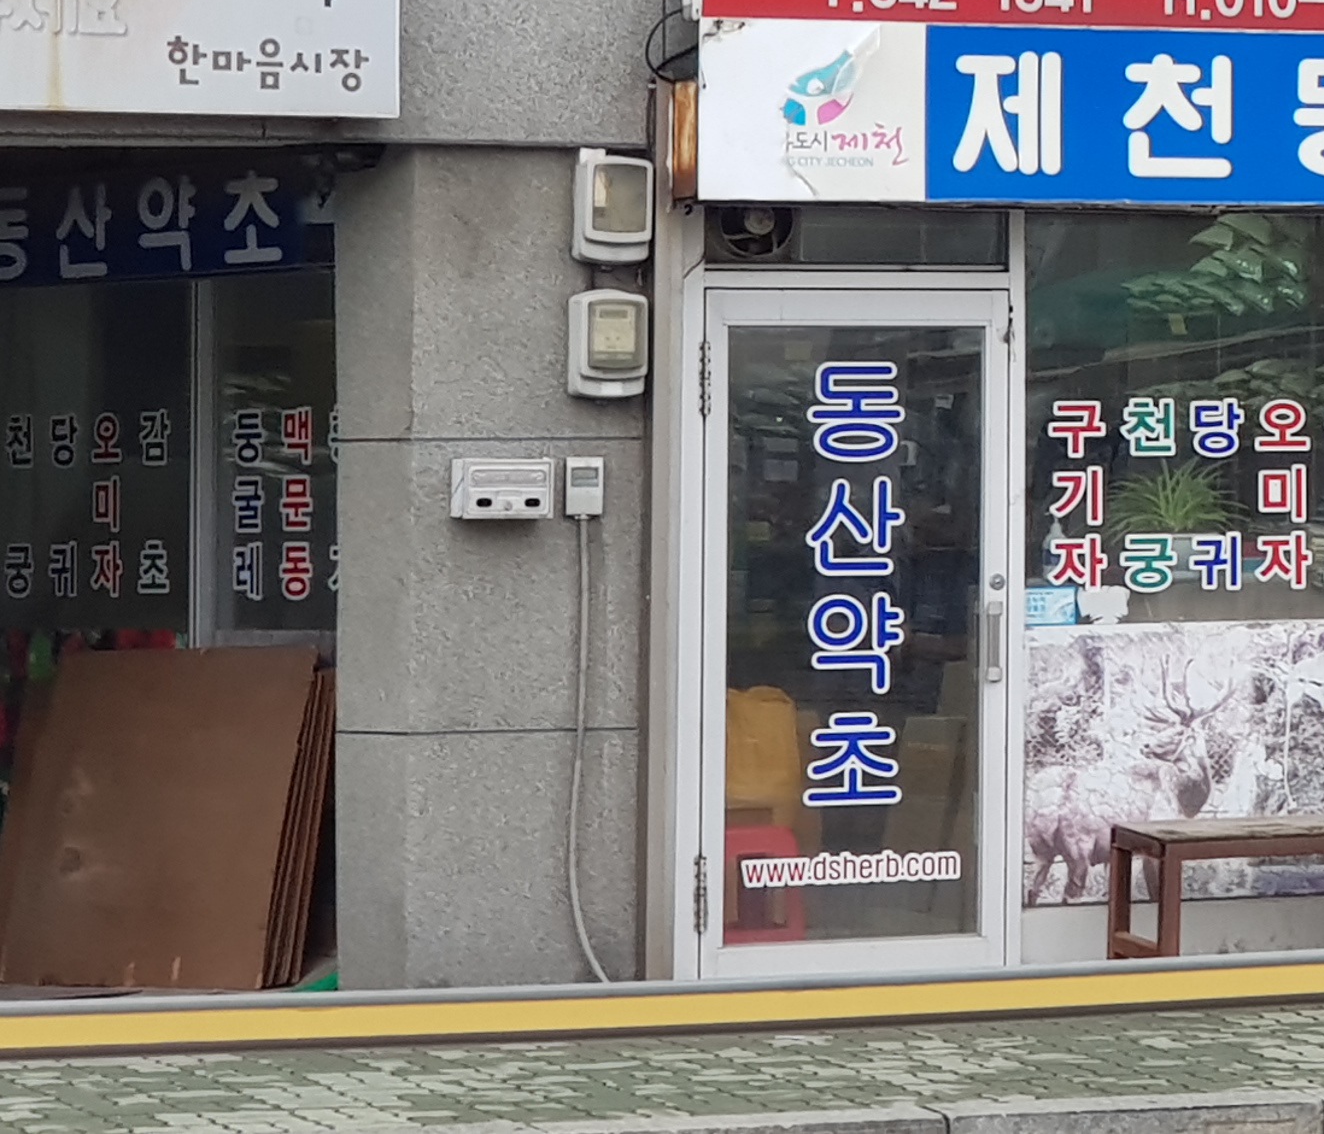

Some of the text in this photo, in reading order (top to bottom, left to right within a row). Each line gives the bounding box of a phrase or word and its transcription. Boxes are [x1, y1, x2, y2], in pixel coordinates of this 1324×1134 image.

[166, 34, 369, 93] 한마음시장
[803, 361, 906, 807] 동산약초
[740, 850, 962, 889] www.dsherb.com
